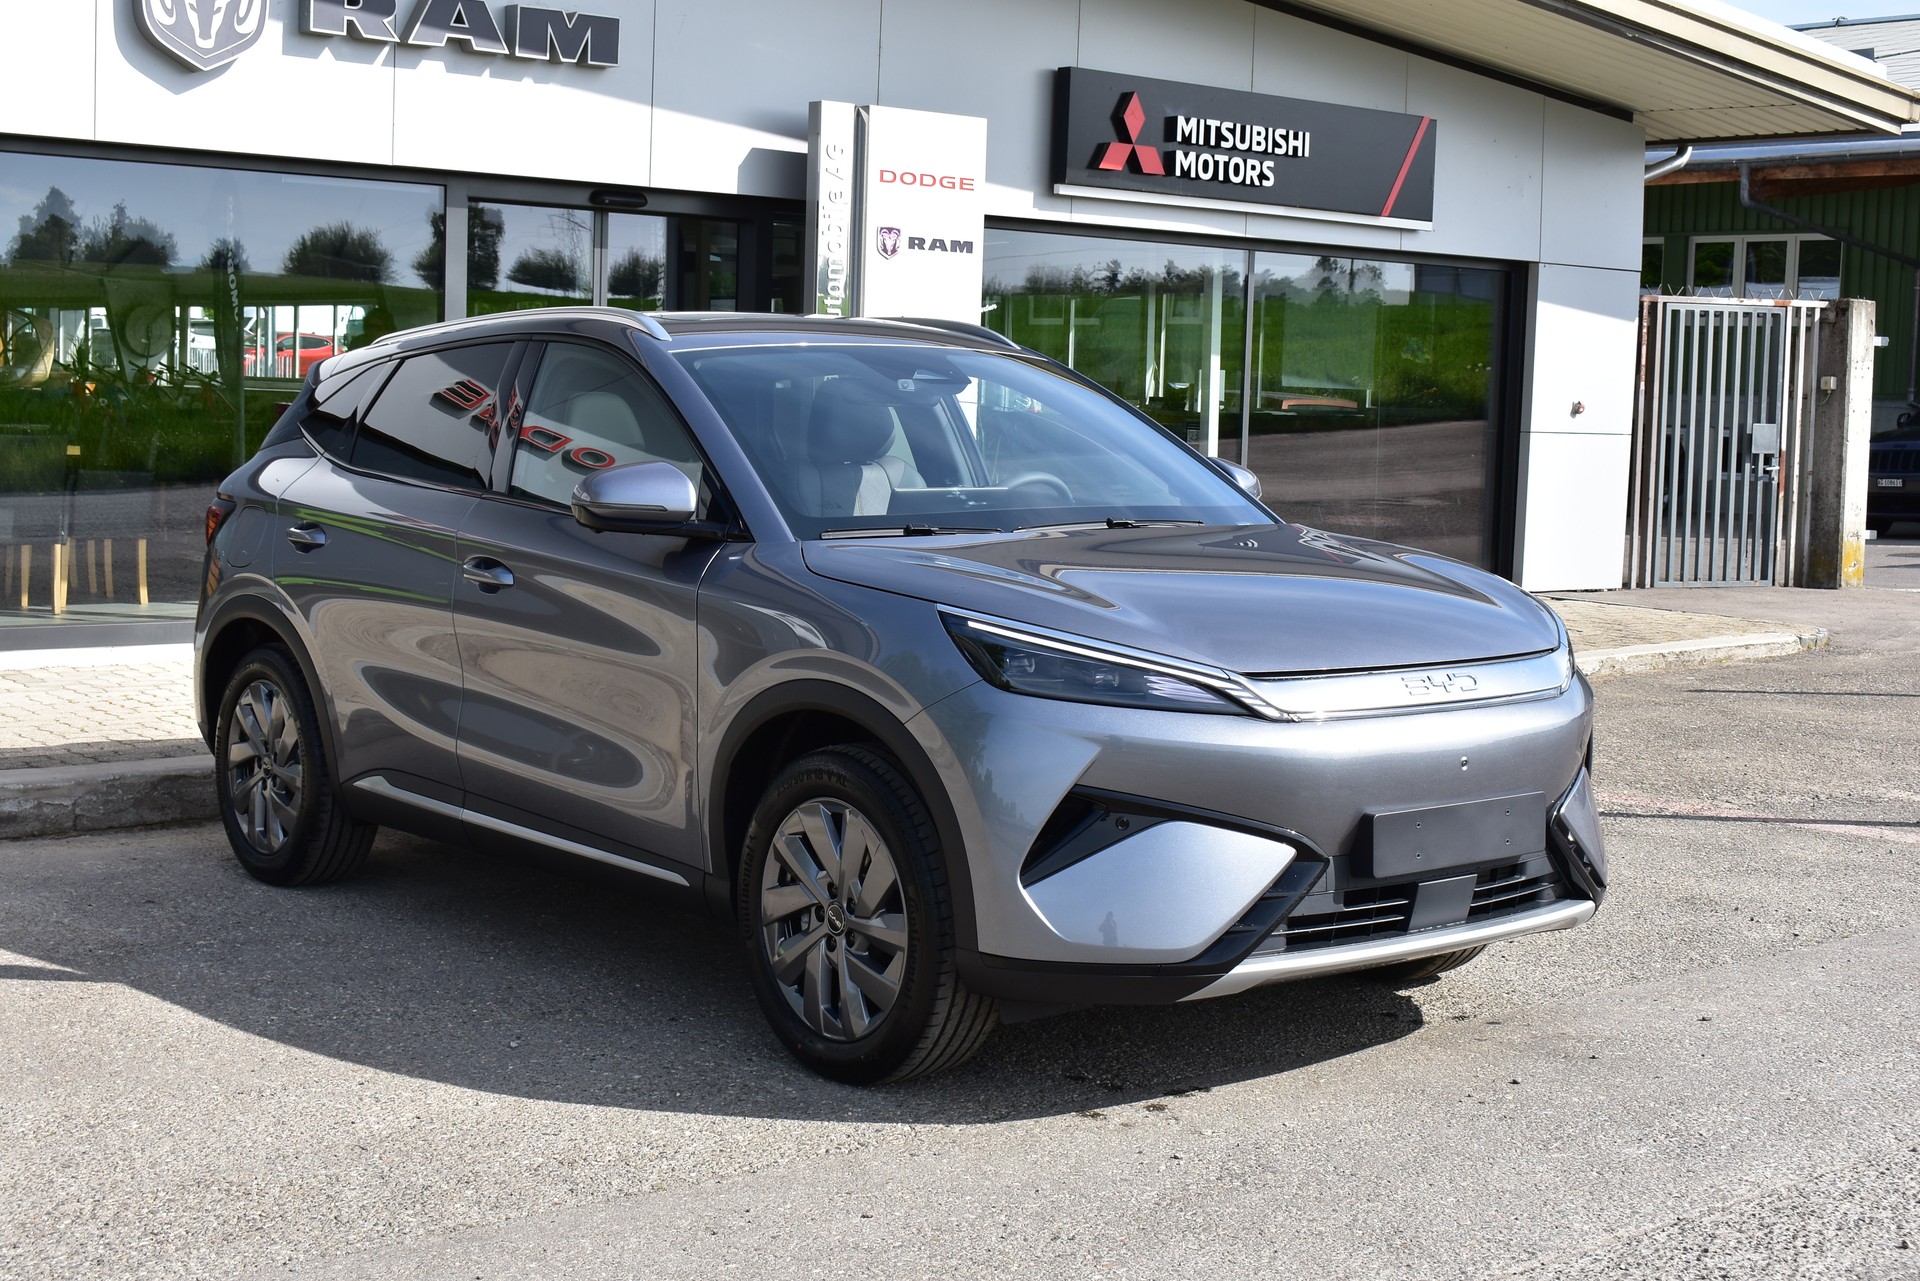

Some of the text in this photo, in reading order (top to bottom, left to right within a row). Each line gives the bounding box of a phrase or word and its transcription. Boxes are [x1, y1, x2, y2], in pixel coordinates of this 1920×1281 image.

[301, 0, 621, 67] RAM
[1175, 115, 1310, 158] MITSUBISHI
[879, 169, 975, 191] DODGE
[1175, 150, 1275, 187] MOTORS
[908, 236, 974, 254] RAM
[1401, 672, 1478, 696] BYD
